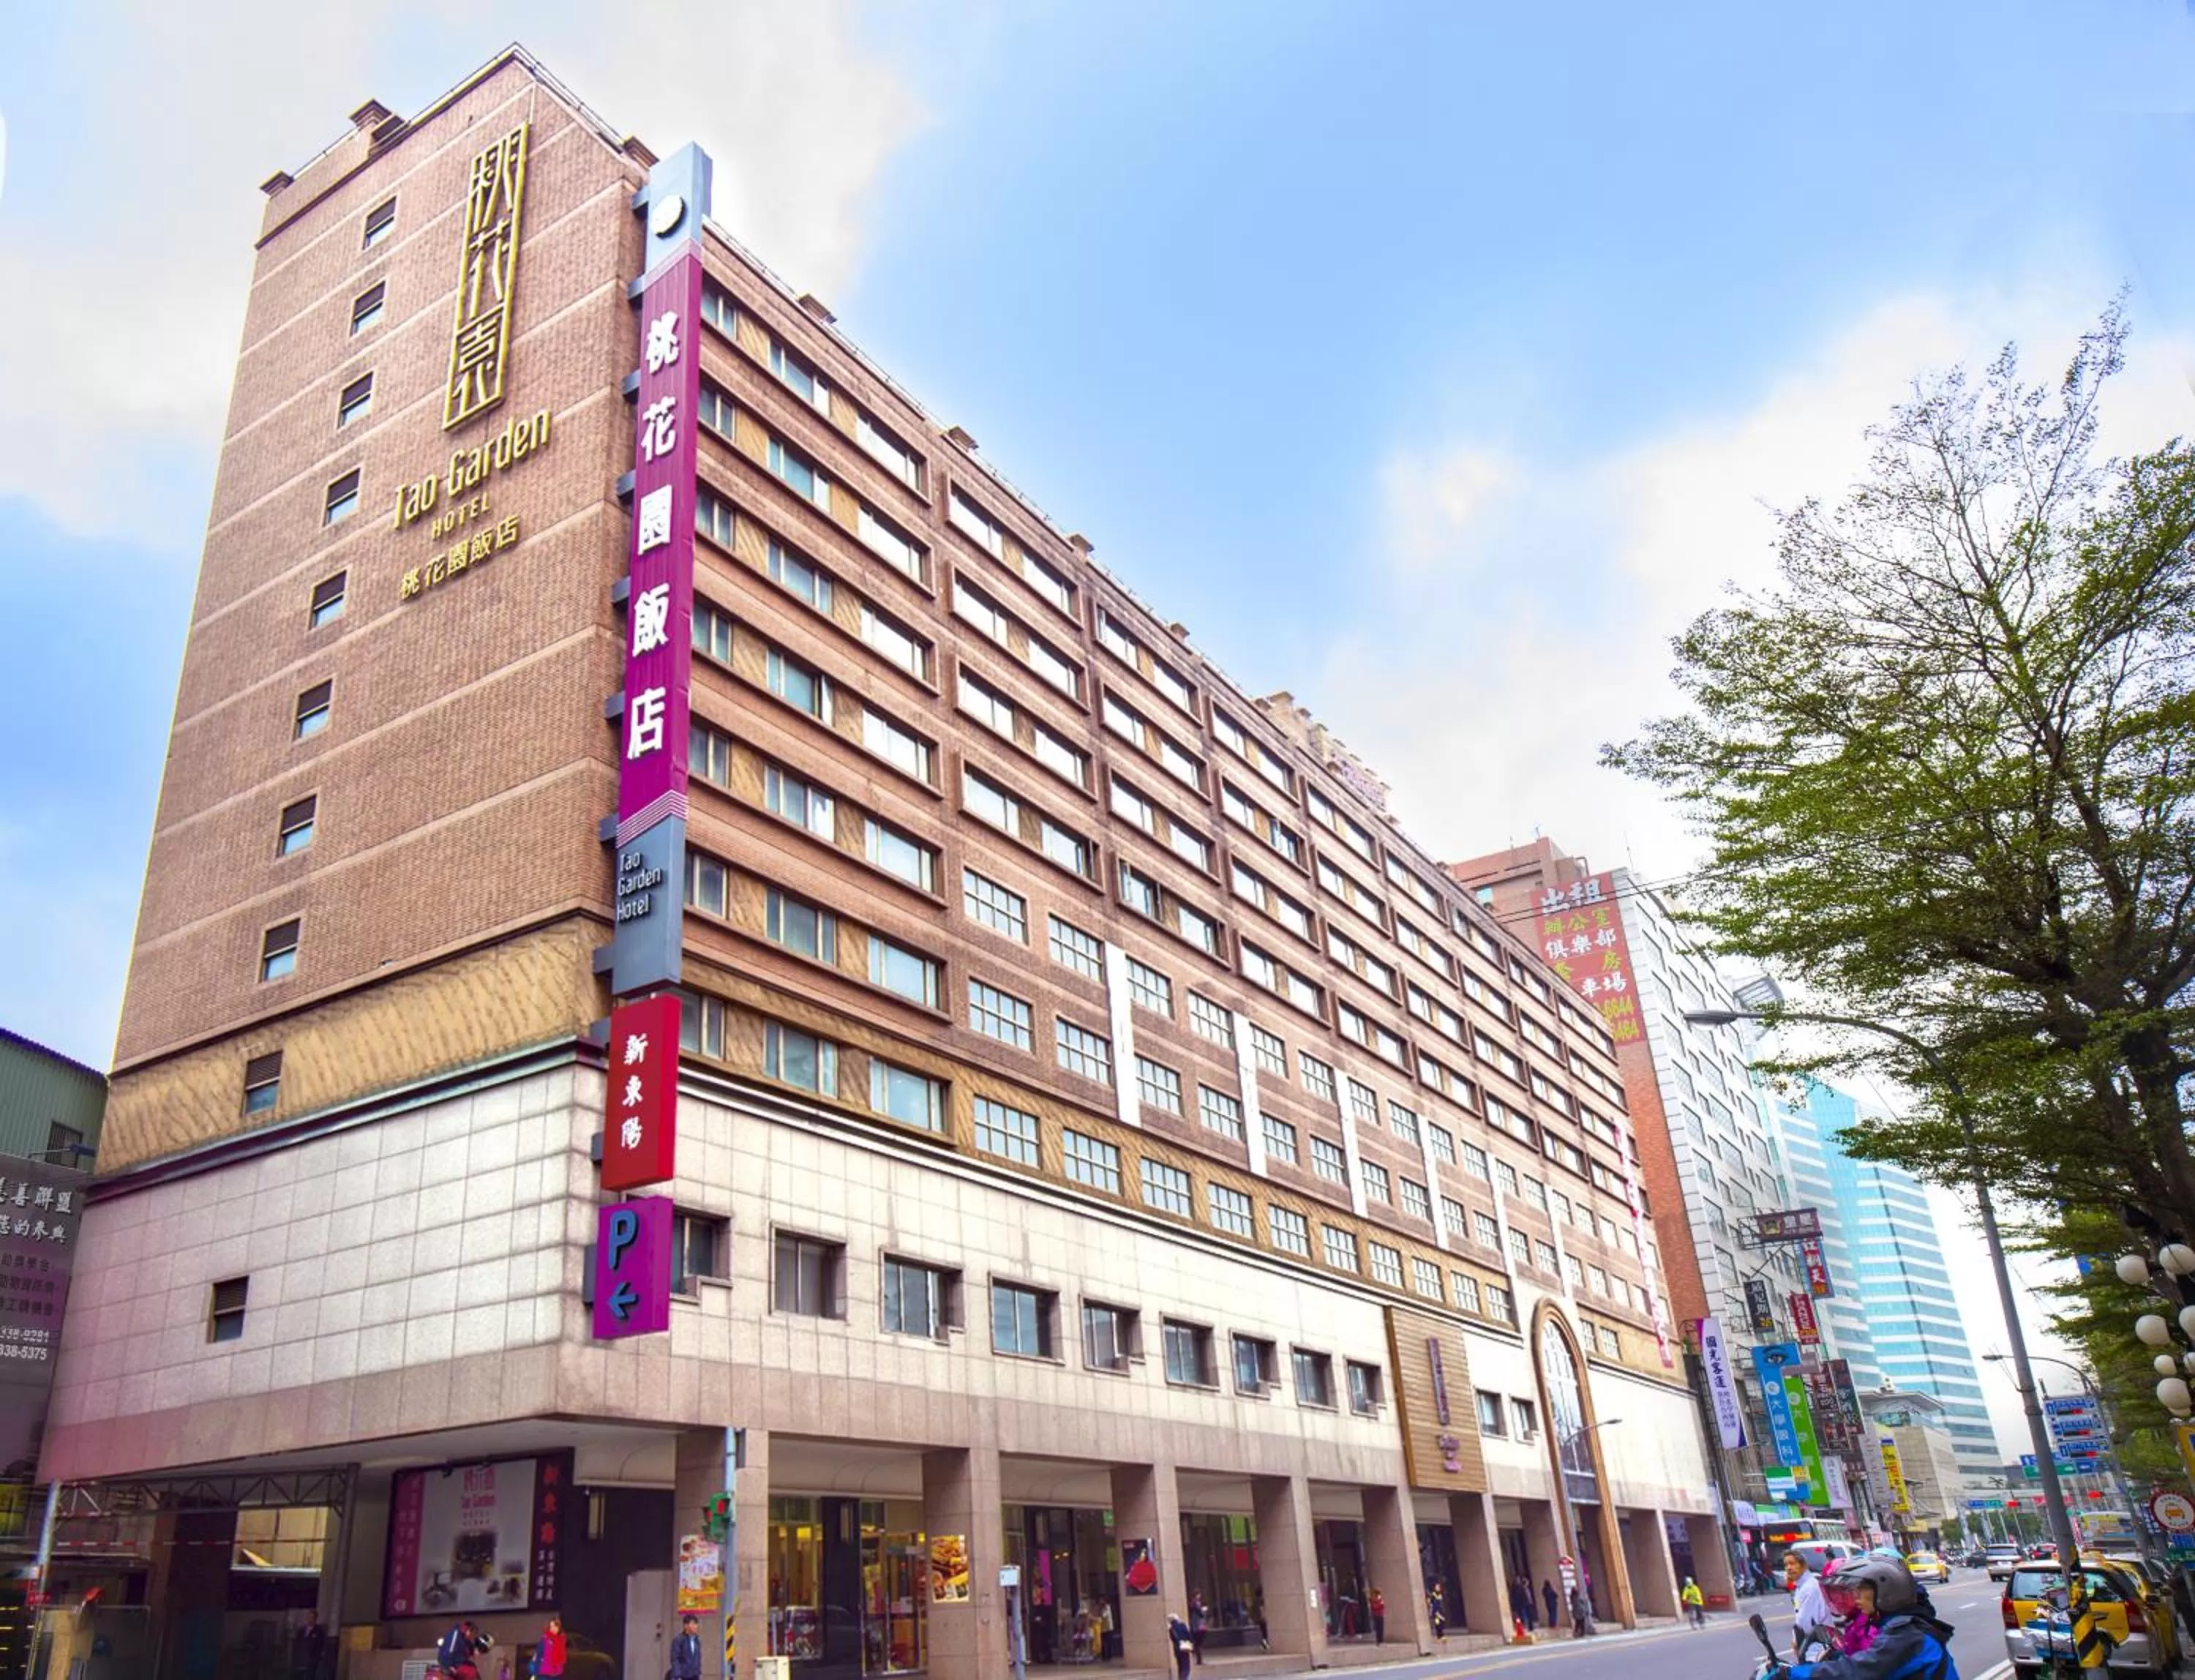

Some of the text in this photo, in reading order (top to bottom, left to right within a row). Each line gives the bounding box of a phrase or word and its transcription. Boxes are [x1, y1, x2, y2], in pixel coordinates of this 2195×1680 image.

[392, 409, 549, 530] Tao Garden
[432, 491, 490, 539] HOTEL
[626, 310, 680, 761] 桃花園飯店
[401, 514, 519, 600] 桃花園飯店
[618, 867, 661, 896] Garden
[620, 852, 641, 873] Tao
[617, 893, 650, 922] Hotel
[1540, 878, 1607, 917] 出租
[1543, 907, 1611, 937] 辦公室
[1545, 928, 1616, 959] 俱樂部
[620, 1032, 649, 1151] 新東陽
[607, 1209, 639, 1271] P
[1706, 1335, 1727, 1388] 國光客運
